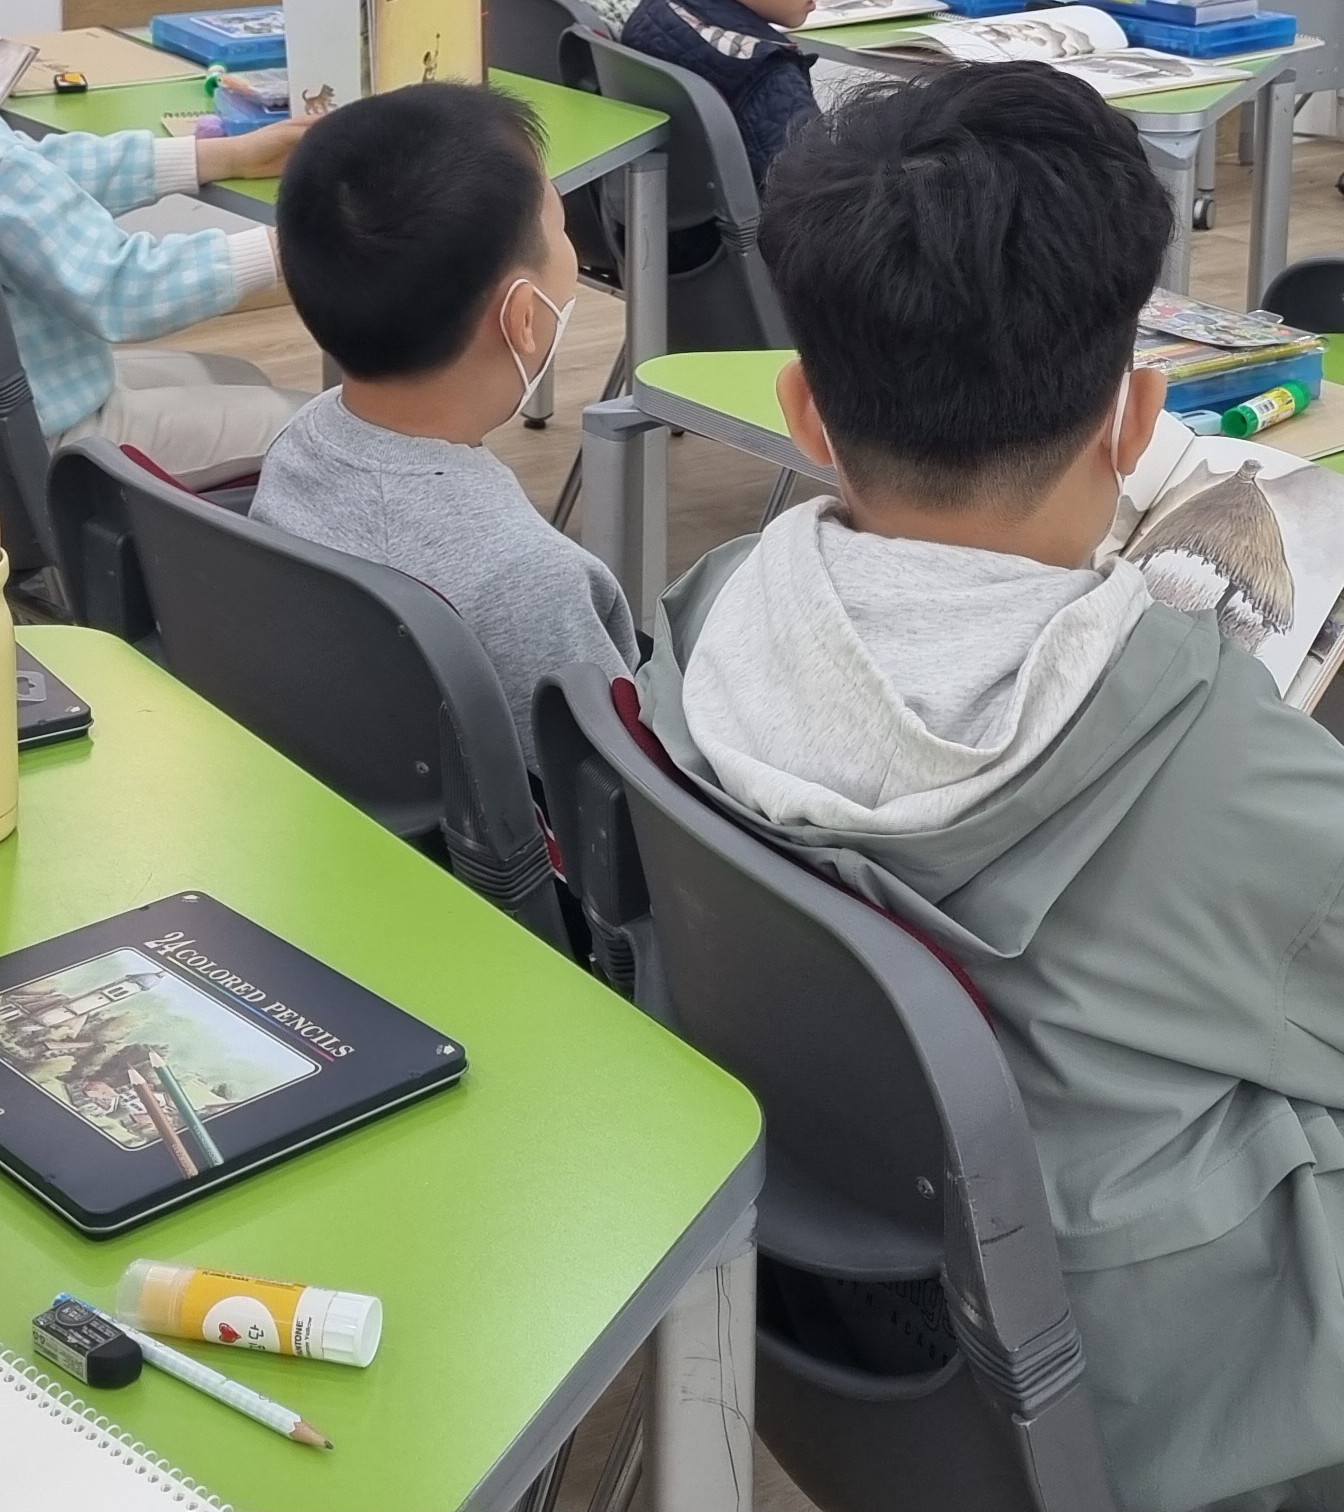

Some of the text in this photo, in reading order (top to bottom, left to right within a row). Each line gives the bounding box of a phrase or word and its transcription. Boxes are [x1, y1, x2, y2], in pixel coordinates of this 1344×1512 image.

[143, 931, 355, 1058] 24 COLORED PENCILS
